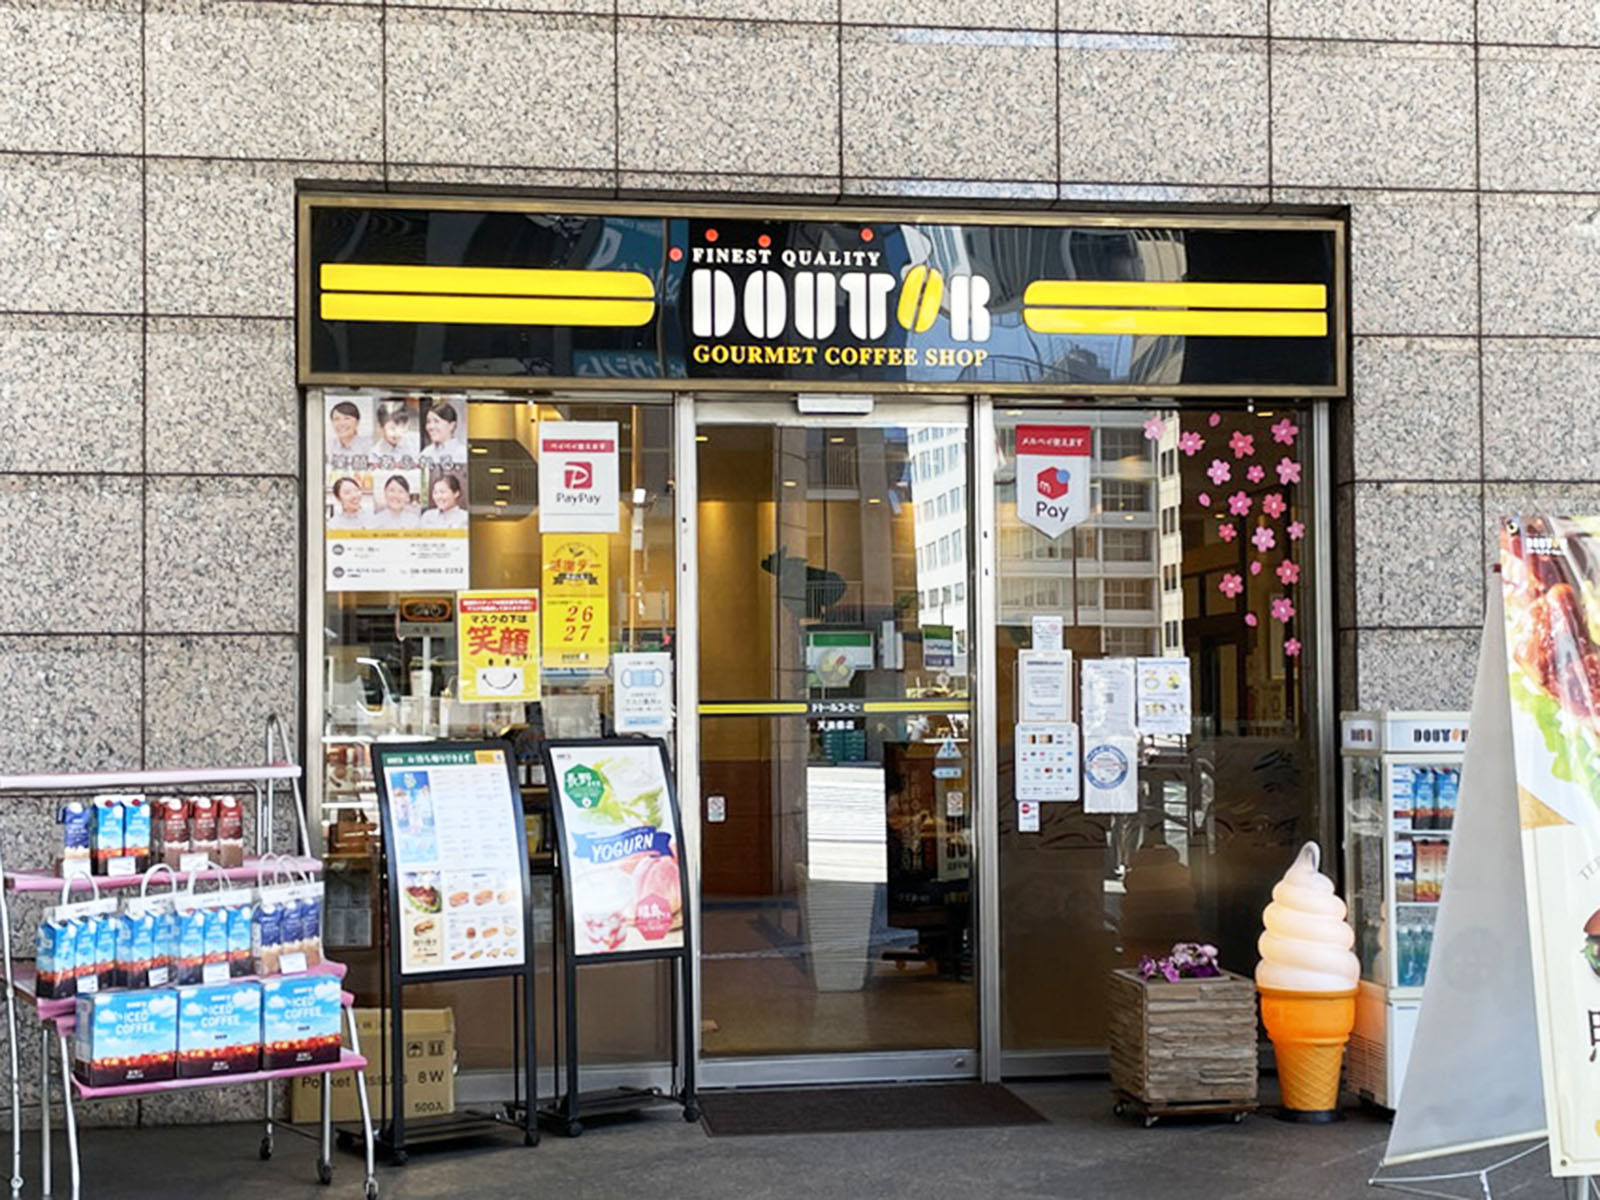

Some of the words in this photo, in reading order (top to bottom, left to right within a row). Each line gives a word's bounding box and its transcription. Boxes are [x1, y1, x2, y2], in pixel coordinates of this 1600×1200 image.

[692, 248, 772, 264] FINEST
[781, 251, 881, 267] QUALITY
[691, 264, 991, 342] DOUTOR
[692, 345, 817, 364] GOURMET
[824, 347, 918, 366] COFFEE
[925, 349, 988, 366] SHOP
[556, 492, 601, 506] PayPay
[1036, 501, 1069, 522] Pay
[470, 614, 528, 624] マスクの下は
[466, 625, 531, 656] 笑顔
[811, 702, 862, 714] ドトールコーヒー
[591, 833, 654, 862] YOGURN
[284, 1006, 323, 1019] COFFEE
[115, 1021, 156, 1035] COFFEE
[201, 1014, 240, 1028] COFFEE
